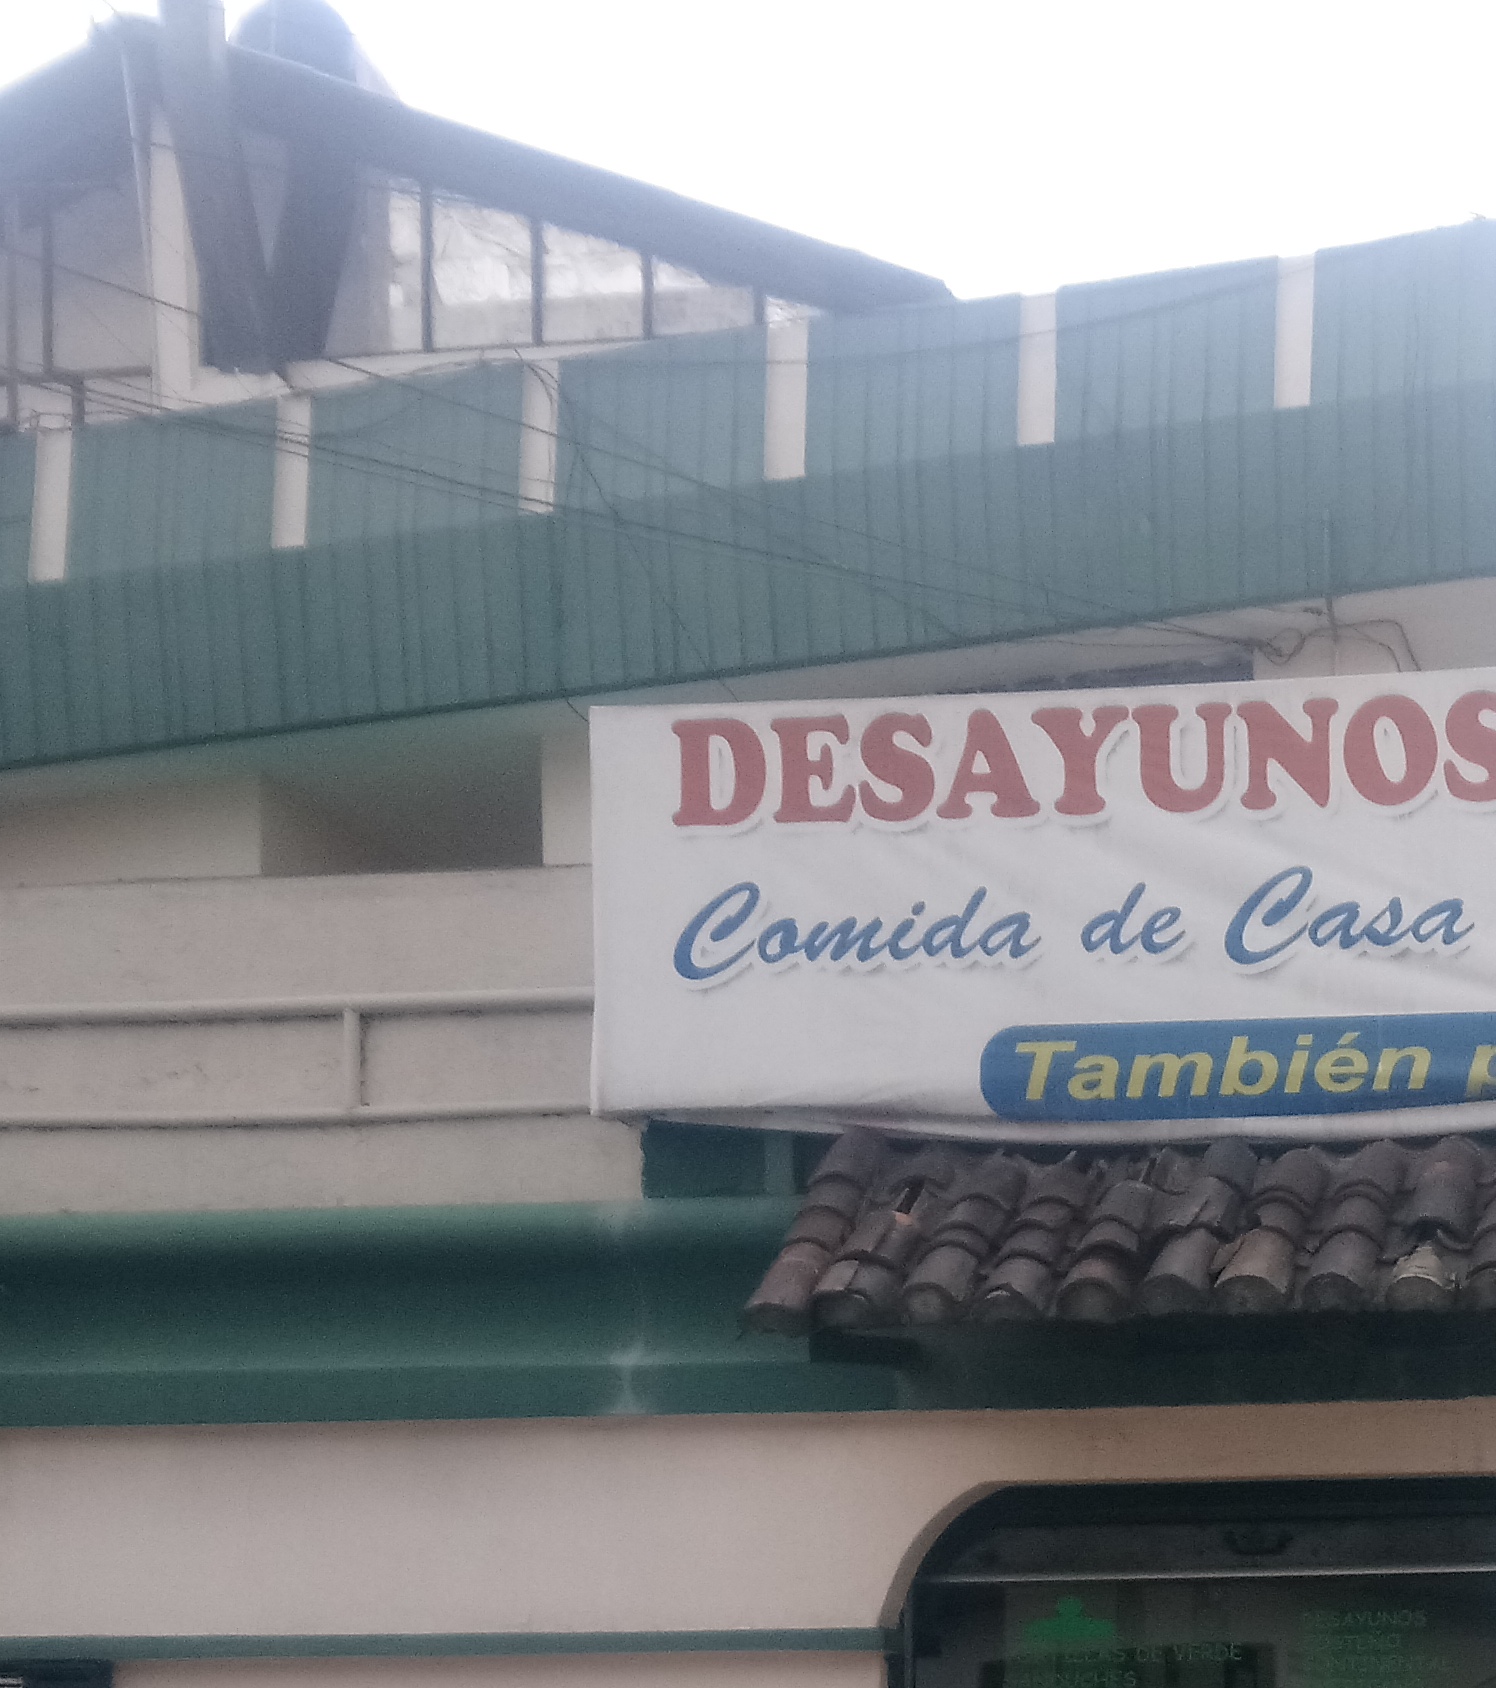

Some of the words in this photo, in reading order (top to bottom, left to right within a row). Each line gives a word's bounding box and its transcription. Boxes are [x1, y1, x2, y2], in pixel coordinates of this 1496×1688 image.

[672, 881, 1041, 982] Comida
[1080, 882, 1187, 956] de
[1223, 866, 1475, 966] Casa
[1013, 1031, 1433, 1101] También
